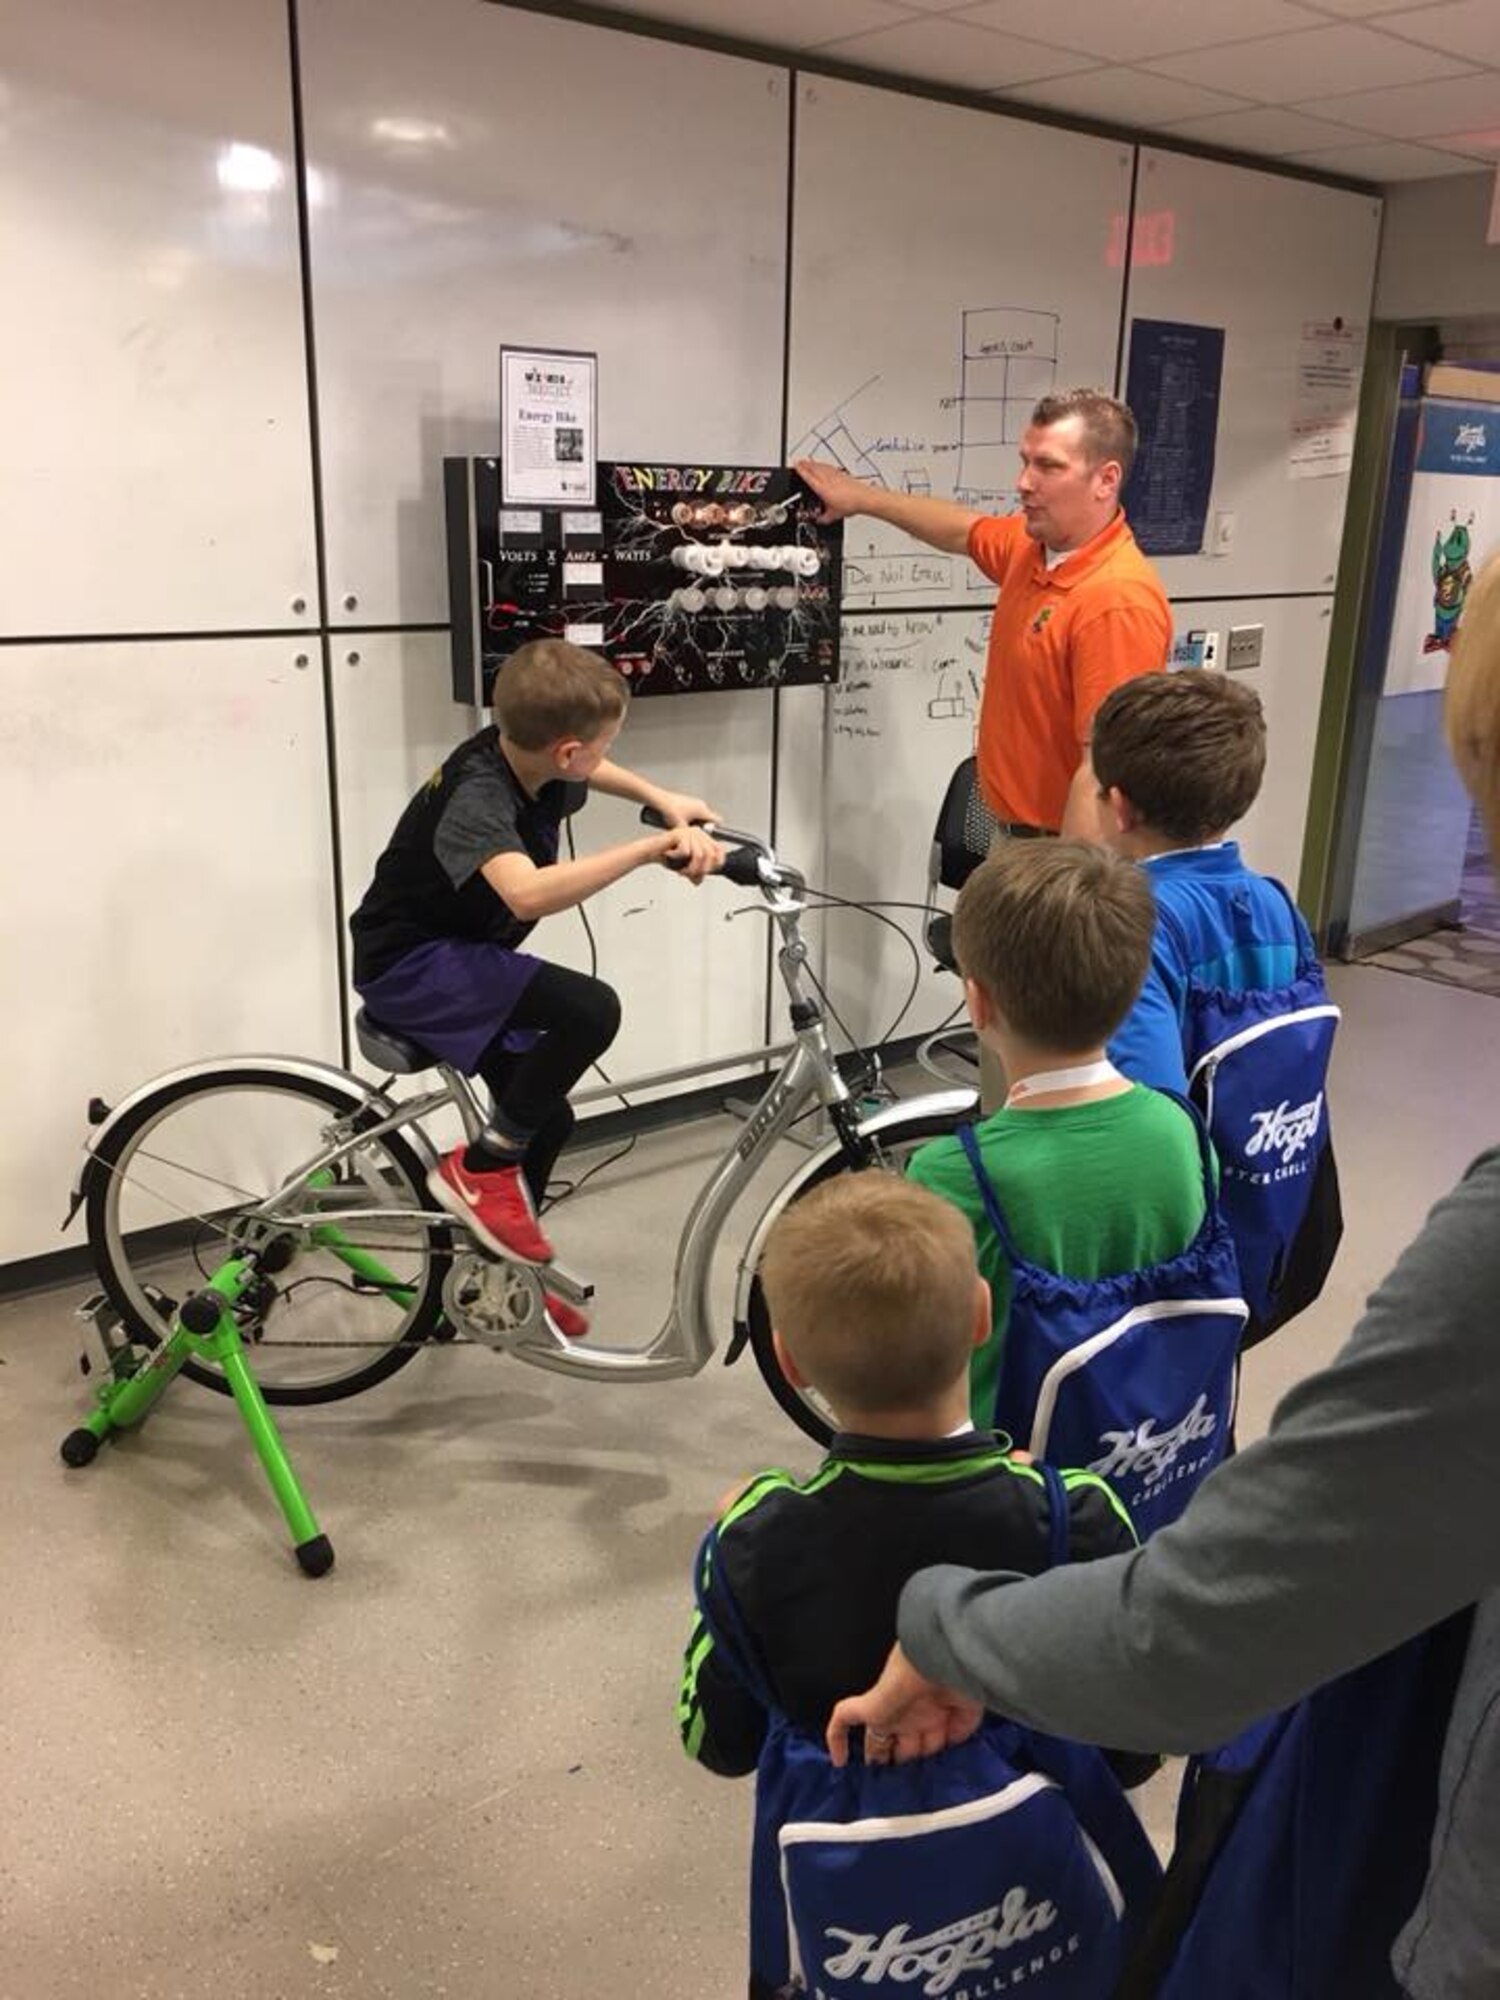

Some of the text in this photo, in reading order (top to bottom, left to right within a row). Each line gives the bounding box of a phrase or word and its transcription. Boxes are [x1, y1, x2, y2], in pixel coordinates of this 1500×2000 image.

[518, 408, 577, 424] Energy Bike
[615, 466, 713, 492] ENERGY
[716, 470, 772, 493] BIKE
[500, 550, 538, 562] VOLTS
[565, 550, 597, 562] AMPS
[615, 550, 652, 562] WATTS
[1244, 1089, 1323, 1164] Hoopl
[823, 1886, 1058, 1996] Hoopla
[939, 1933, 1080, 2000] ALLENGE
